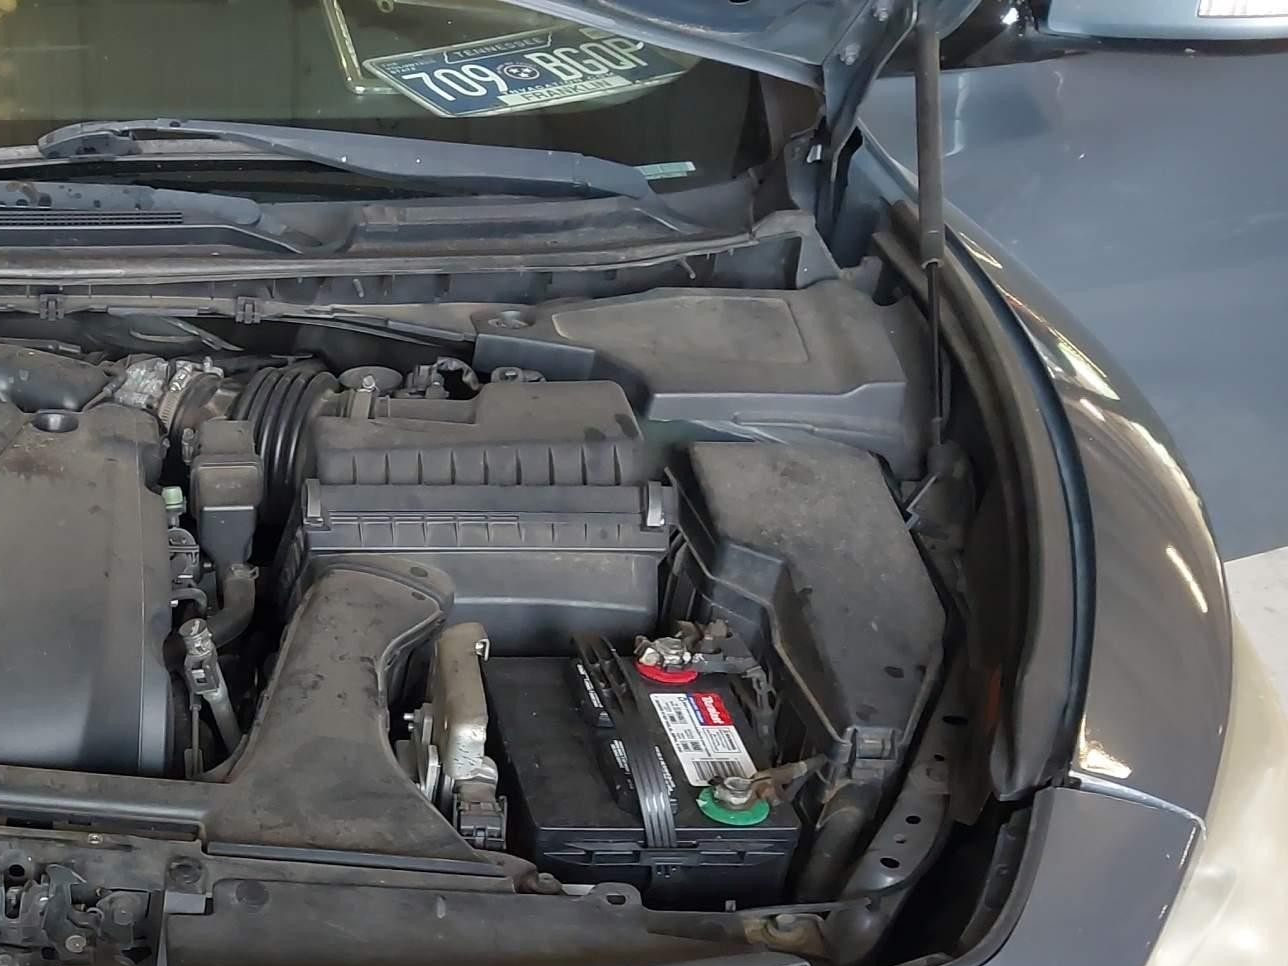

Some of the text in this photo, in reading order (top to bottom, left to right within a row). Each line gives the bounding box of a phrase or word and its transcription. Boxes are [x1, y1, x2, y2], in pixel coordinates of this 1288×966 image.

[453, 36, 544, 58] TENNESSEE
[401, 64, 509, 101] 709
[521, 79, 611, 101] FRANKLIN
